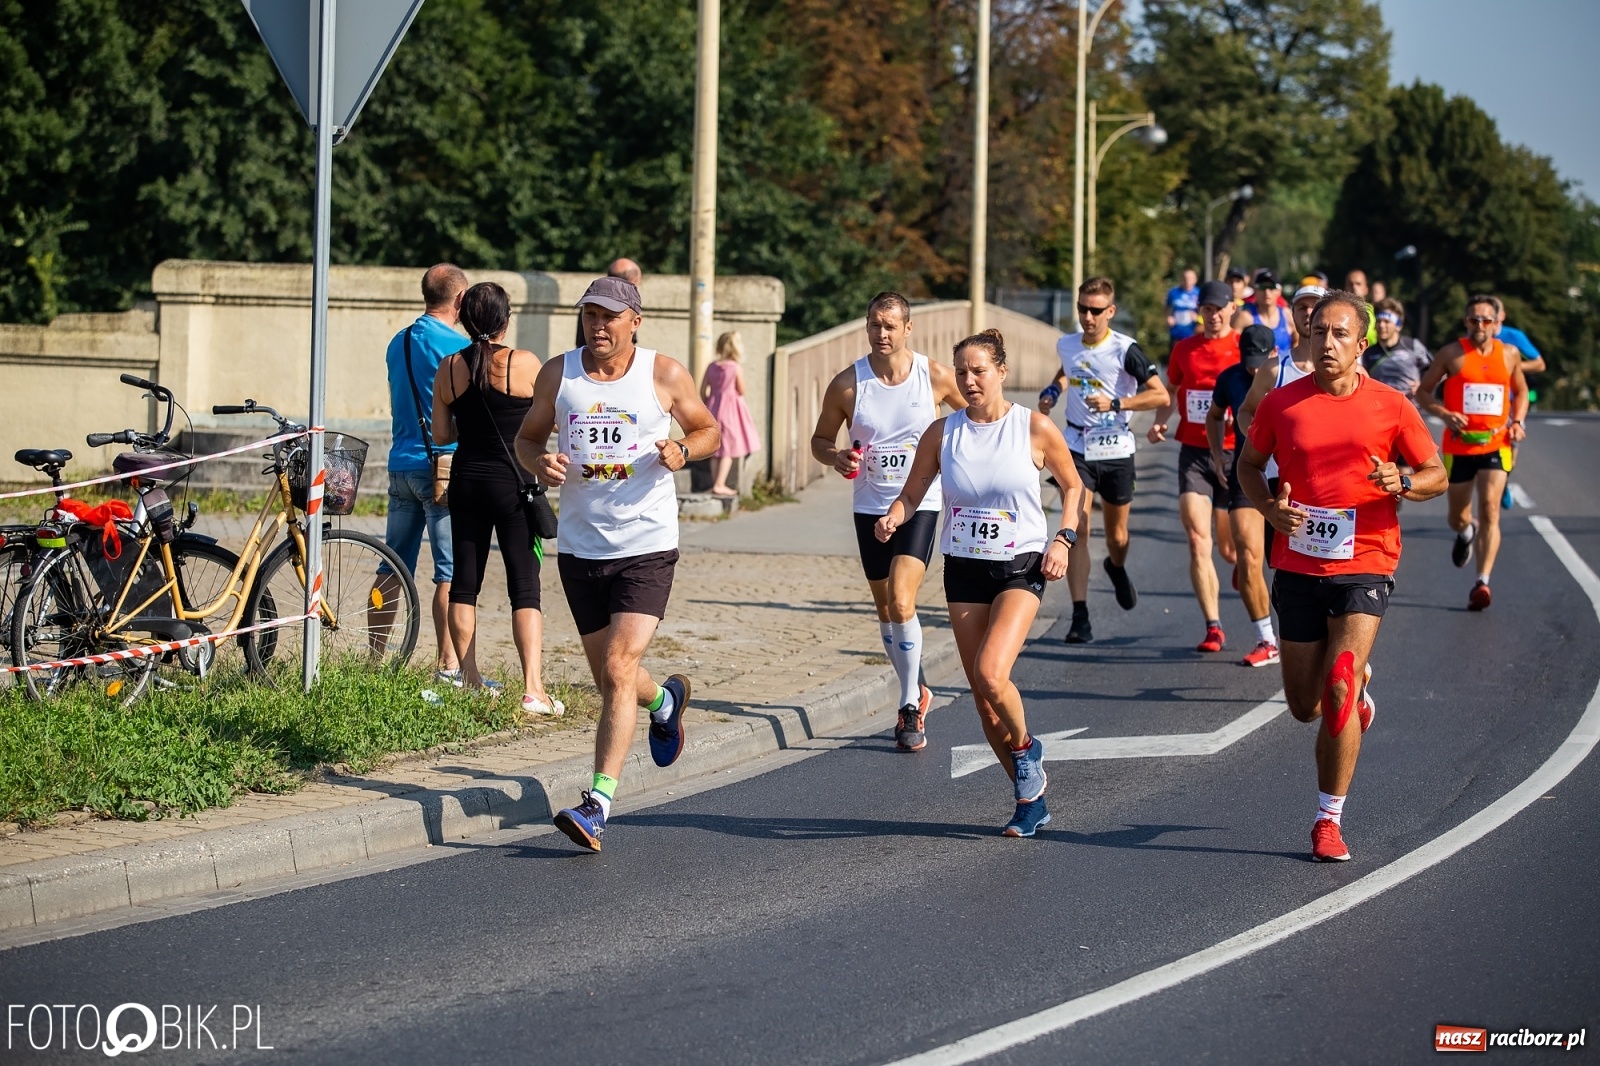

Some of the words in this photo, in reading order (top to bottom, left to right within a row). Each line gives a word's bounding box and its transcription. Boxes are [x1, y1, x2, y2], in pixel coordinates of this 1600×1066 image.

[1478, 393, 1495, 402] 179
[1197, 400, 1209, 410] 35
[589, 427, 622, 443] 316
[1098, 434, 1119, 446] 262
[881, 454, 907, 468] 307
[970, 521, 1000, 540] 143
[1306, 520, 1338, 539] 349
